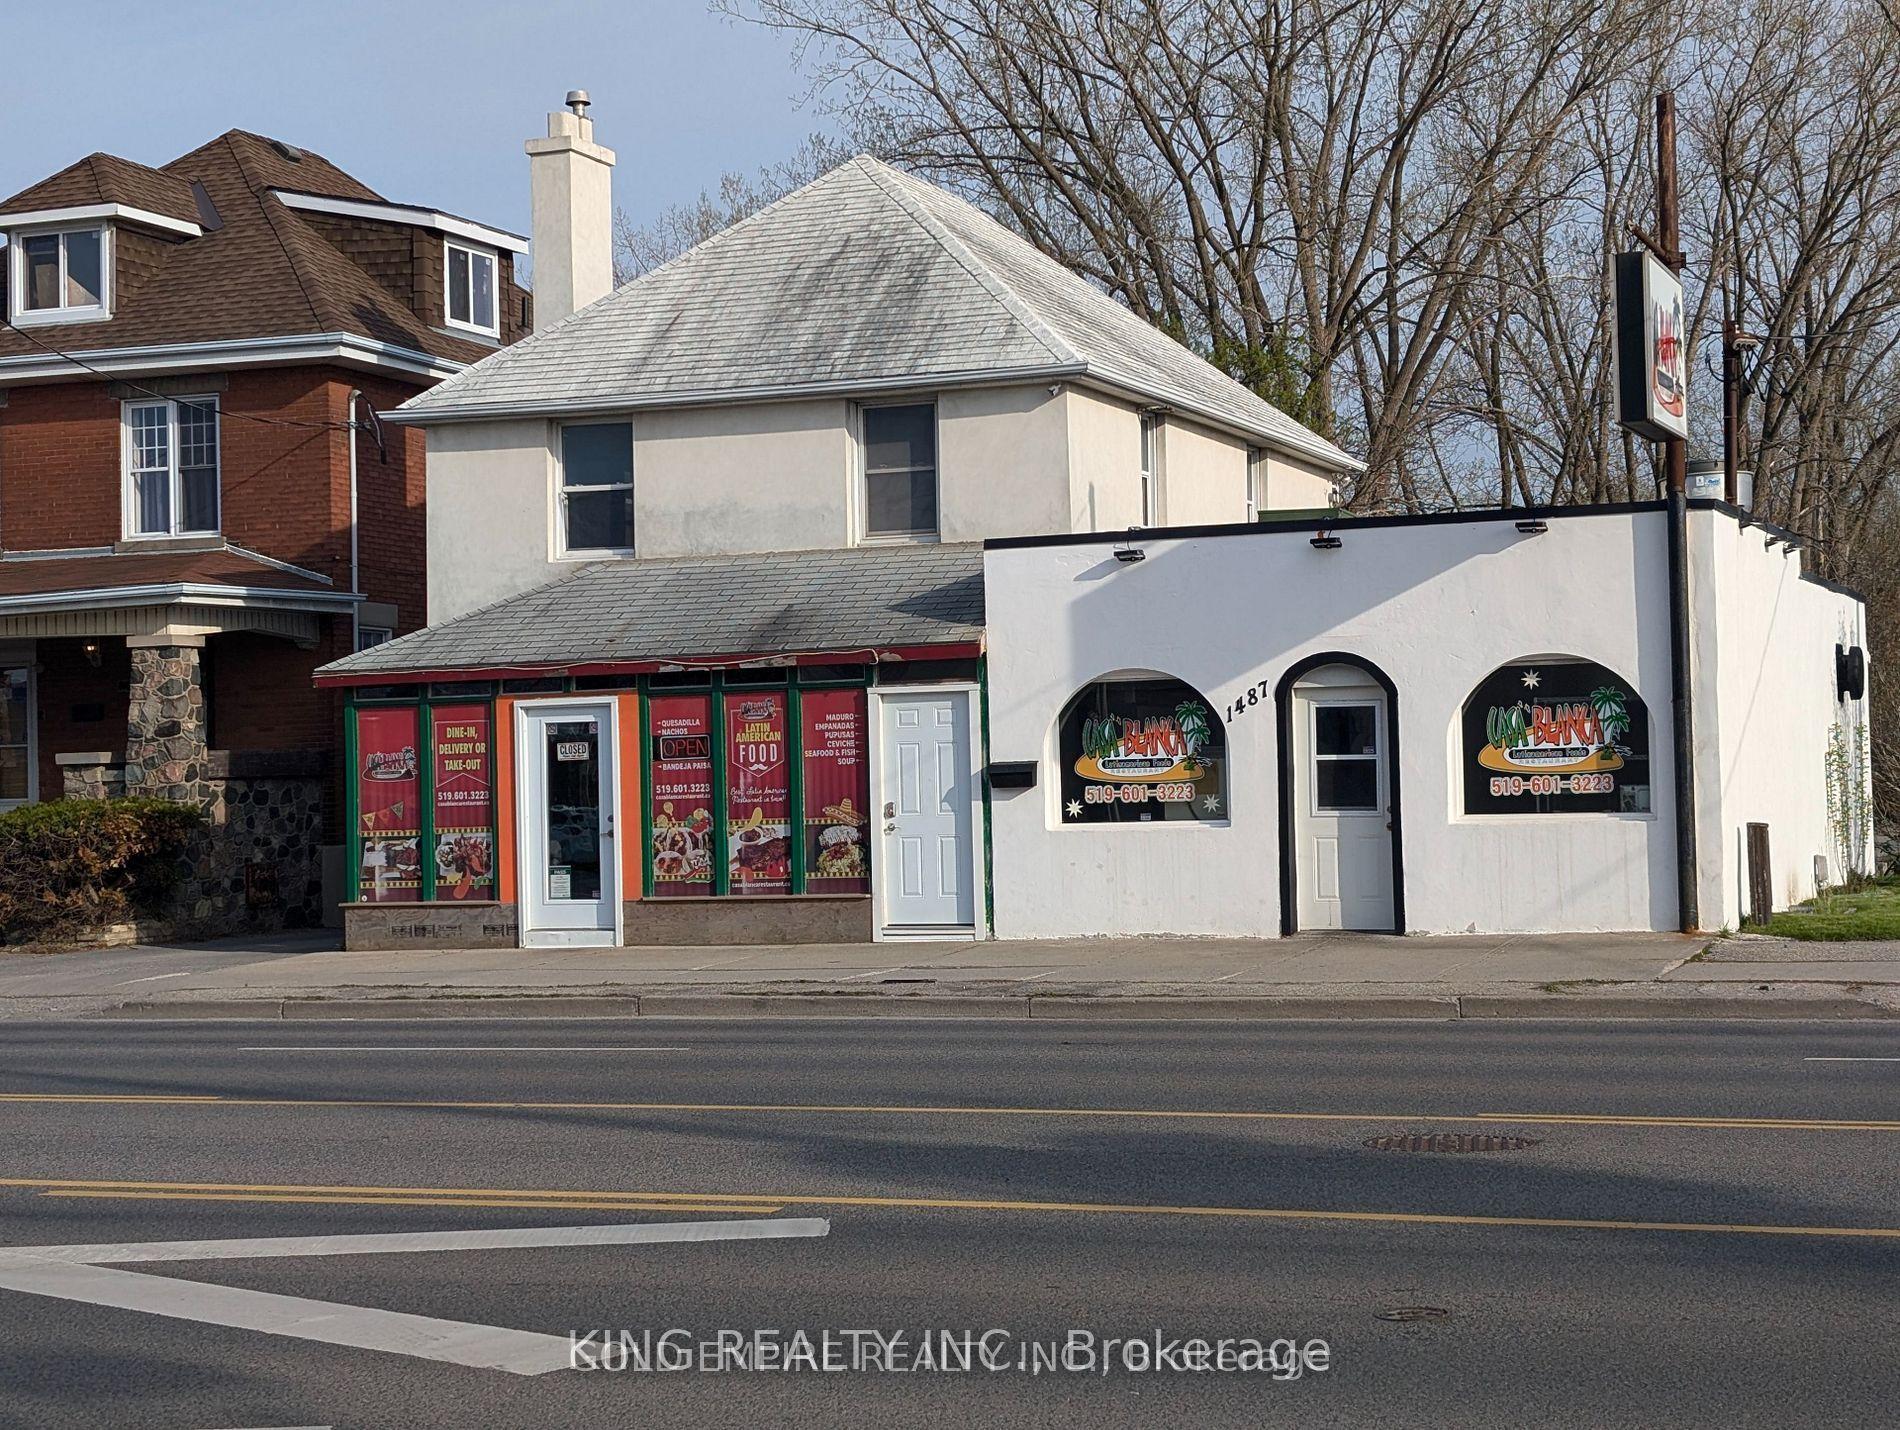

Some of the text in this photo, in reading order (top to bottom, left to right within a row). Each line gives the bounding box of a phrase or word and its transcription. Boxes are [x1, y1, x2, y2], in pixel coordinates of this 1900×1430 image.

[1226, 680, 1268, 723] 1487
[825, 713, 855, 721] MADURO
[661, 719, 700, 727] QUESADILLA
[745, 722, 771, 733] LATIN
[815, 722, 855, 730] EMPANADAS
[1486, 702, 1605, 750] CASA BLANCA
[446, 726, 478, 739] DINE-IN,
[735, 731, 781, 743] AMERICAN
[824, 731, 855, 739] PUPUSAS
[1082, 716, 1188, 760] CASA BLANCA
[439, 743, 486, 754] DELIVERY OR
[560, 744, 587, 755] CLOSED
[663, 738, 707, 757] OPEN
[740, 743, 778, 763] FOOD
[804, 750, 834, 758] SEAFOOD
[841, 748, 856, 756] FISH
[444, 759, 481, 771] TAKE-OUT
[663, 762, 711, 771] BANDEJA PAISA
[837, 757, 856, 765] SOUP
[656, 784, 710, 794] 519.601.3223
[1490, 774, 1614, 796] 519-601-3223
[438, 791, 489, 801] 519.601.3223
[1084, 783, 1195, 804] 519-601-3223
